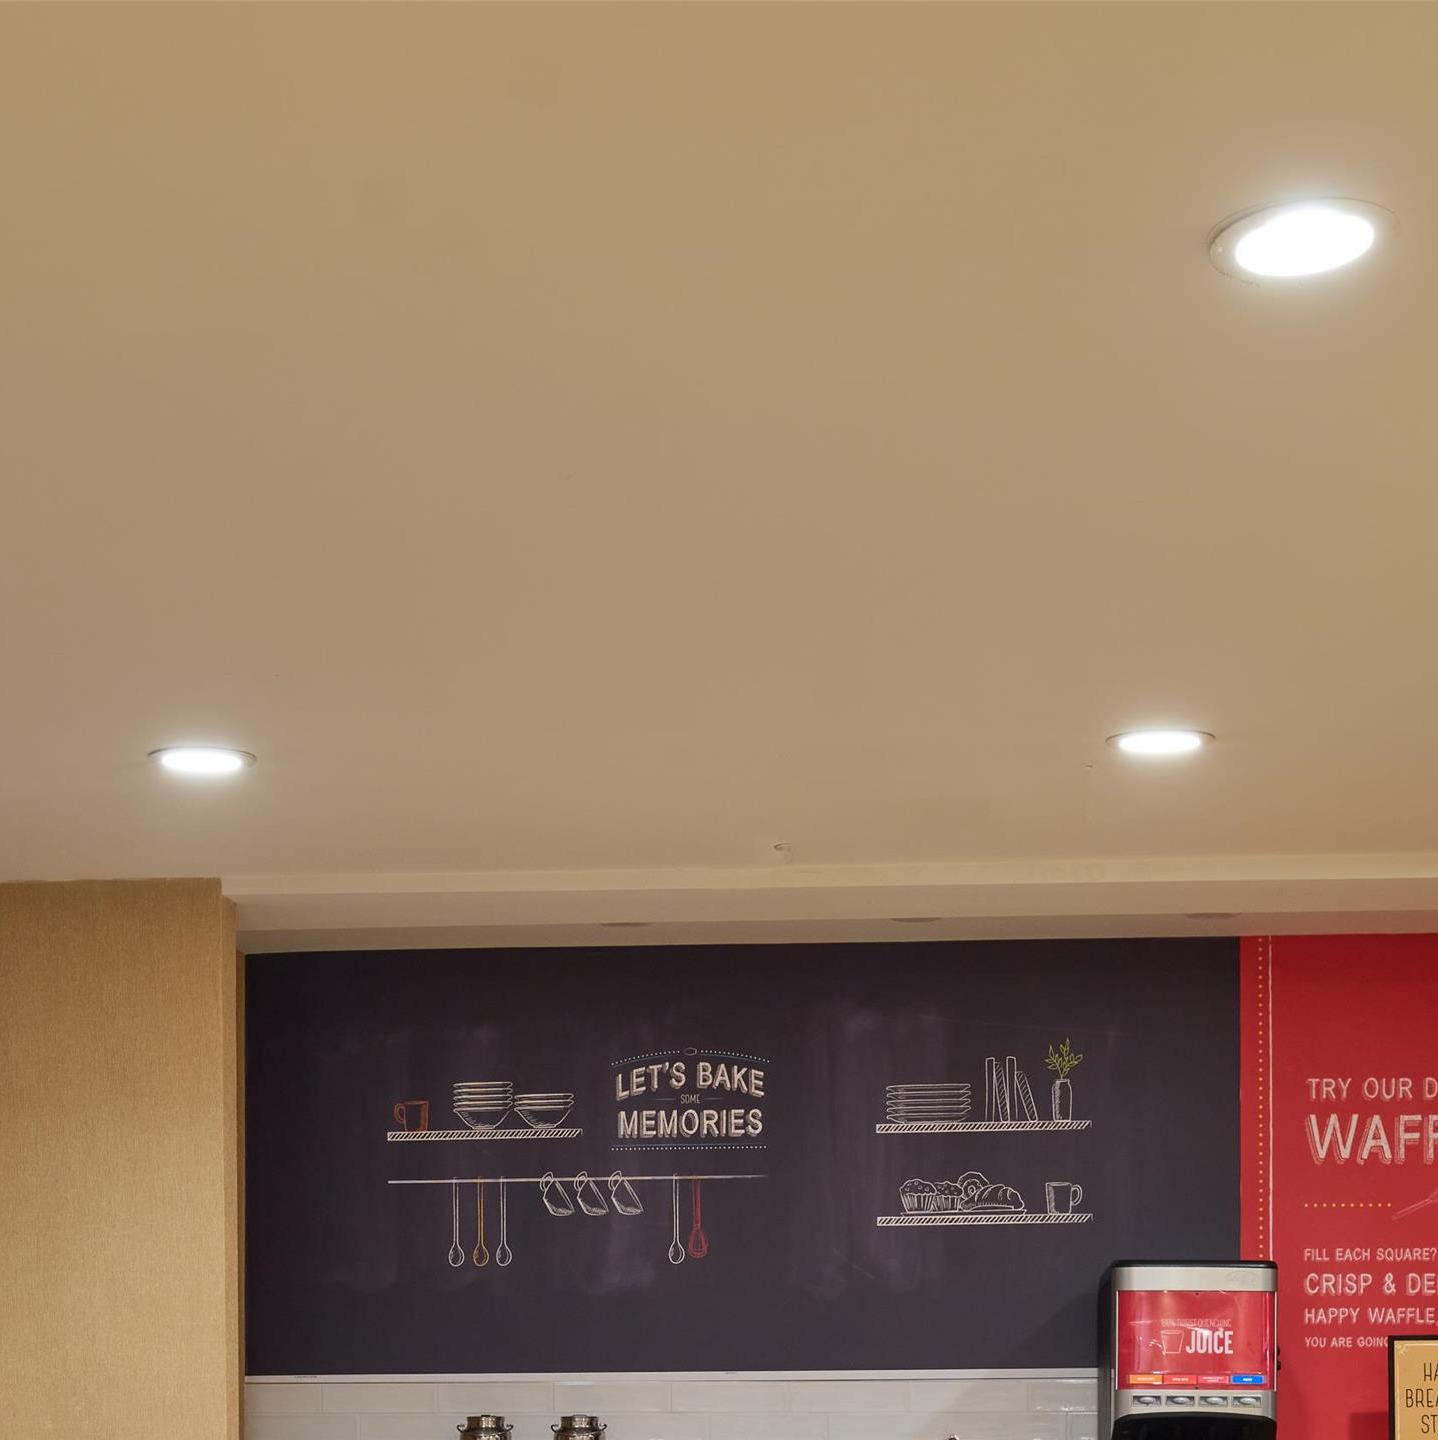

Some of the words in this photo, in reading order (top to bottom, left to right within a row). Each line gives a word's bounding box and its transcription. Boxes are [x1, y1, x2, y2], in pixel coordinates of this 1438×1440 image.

[616, 1062, 686, 1100] LET'S
[696, 1062, 765, 1098] BAKE
[1305, 1078, 1352, 1100] TRY
[1362, 1076, 1414, 1100] OUR
[680, 1094, 701, 1104] SOME
[618, 1108, 763, 1138] MEMORIES
[1304, 1248, 1330, 1262] FILL
[1335, 1248, 1370, 1262] EACH
[1376, 1247, 1437, 1262] SQUARE?
[1304, 1272, 1372, 1296] CRISP
[1384, 1272, 1397, 1296] &
[1304, 1307, 1360, 1325] HAPPY
[1186, 1331, 1234, 1354] JUICE
[1304, 1336, 1326, 1348] YOU
[1330, 1336, 1352, 1348] ARE
